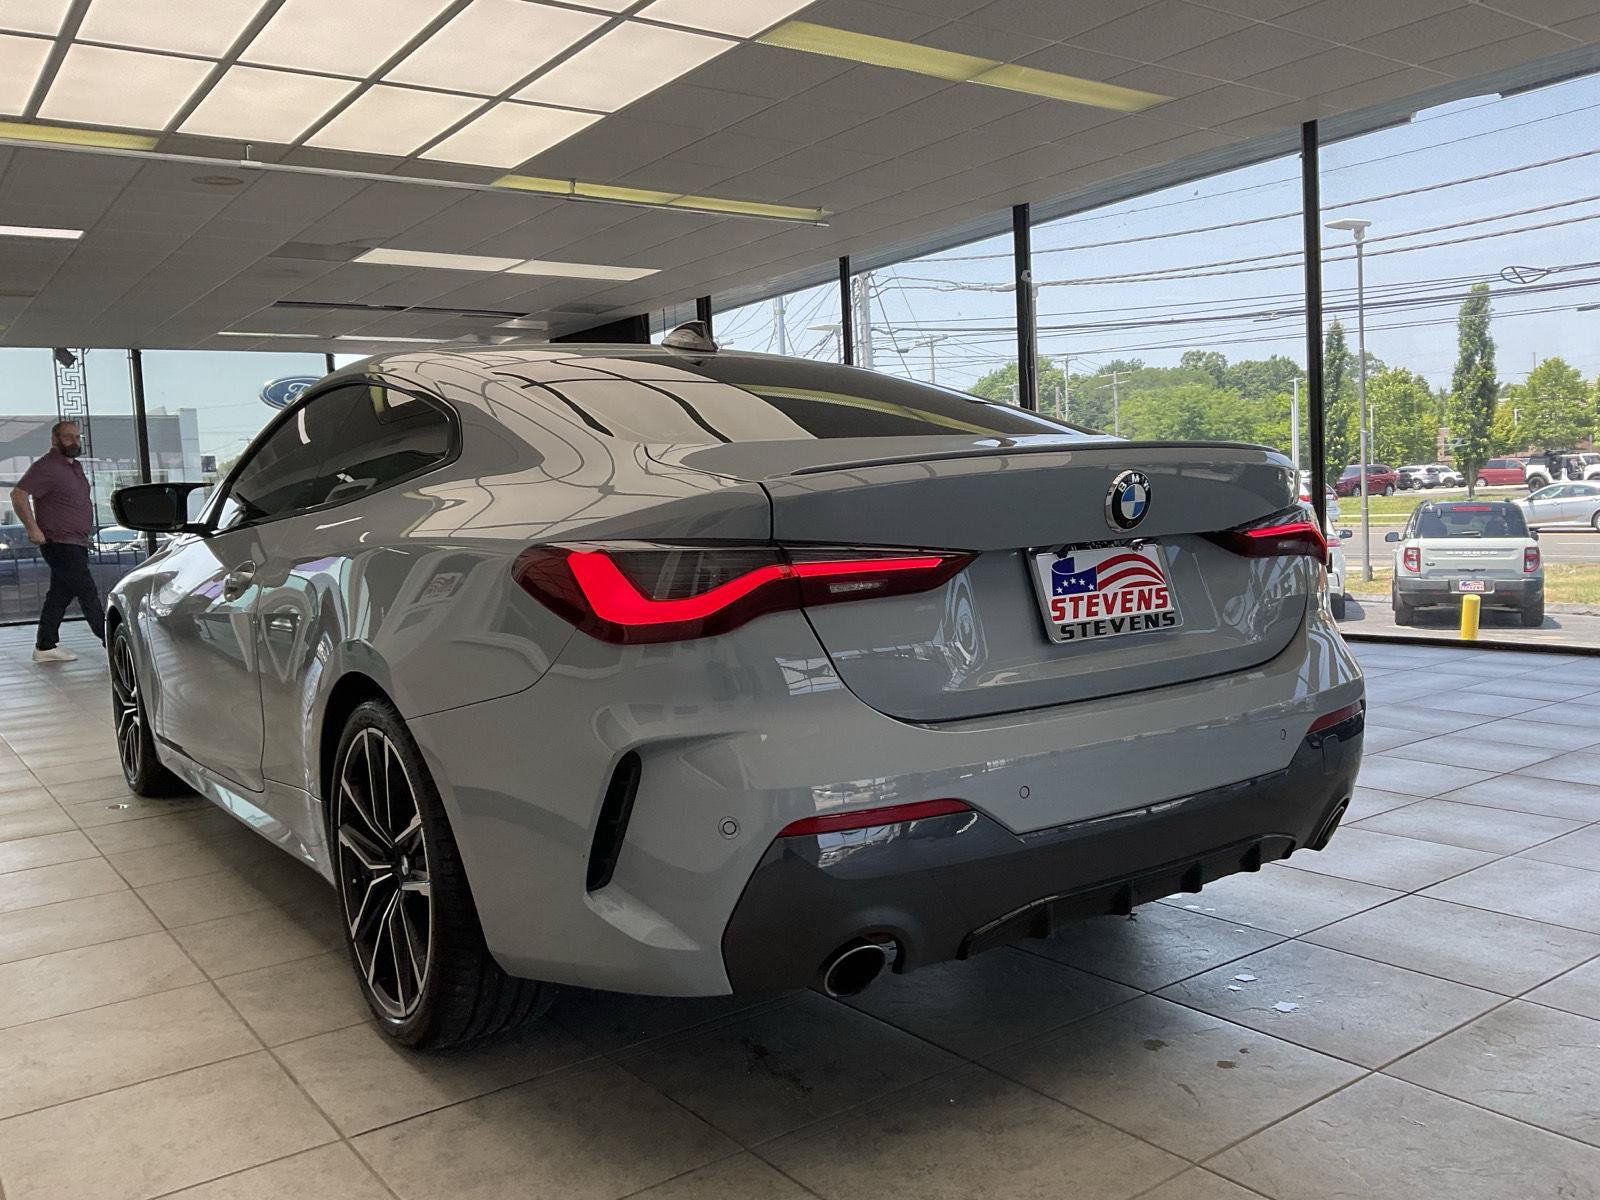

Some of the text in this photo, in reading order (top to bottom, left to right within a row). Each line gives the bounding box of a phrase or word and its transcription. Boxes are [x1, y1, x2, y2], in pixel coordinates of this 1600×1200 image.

[1118, 473, 1150, 492] BMW
[1051, 586, 1168, 621] STEVENS
[1060, 611, 1175, 640] STEVENS
